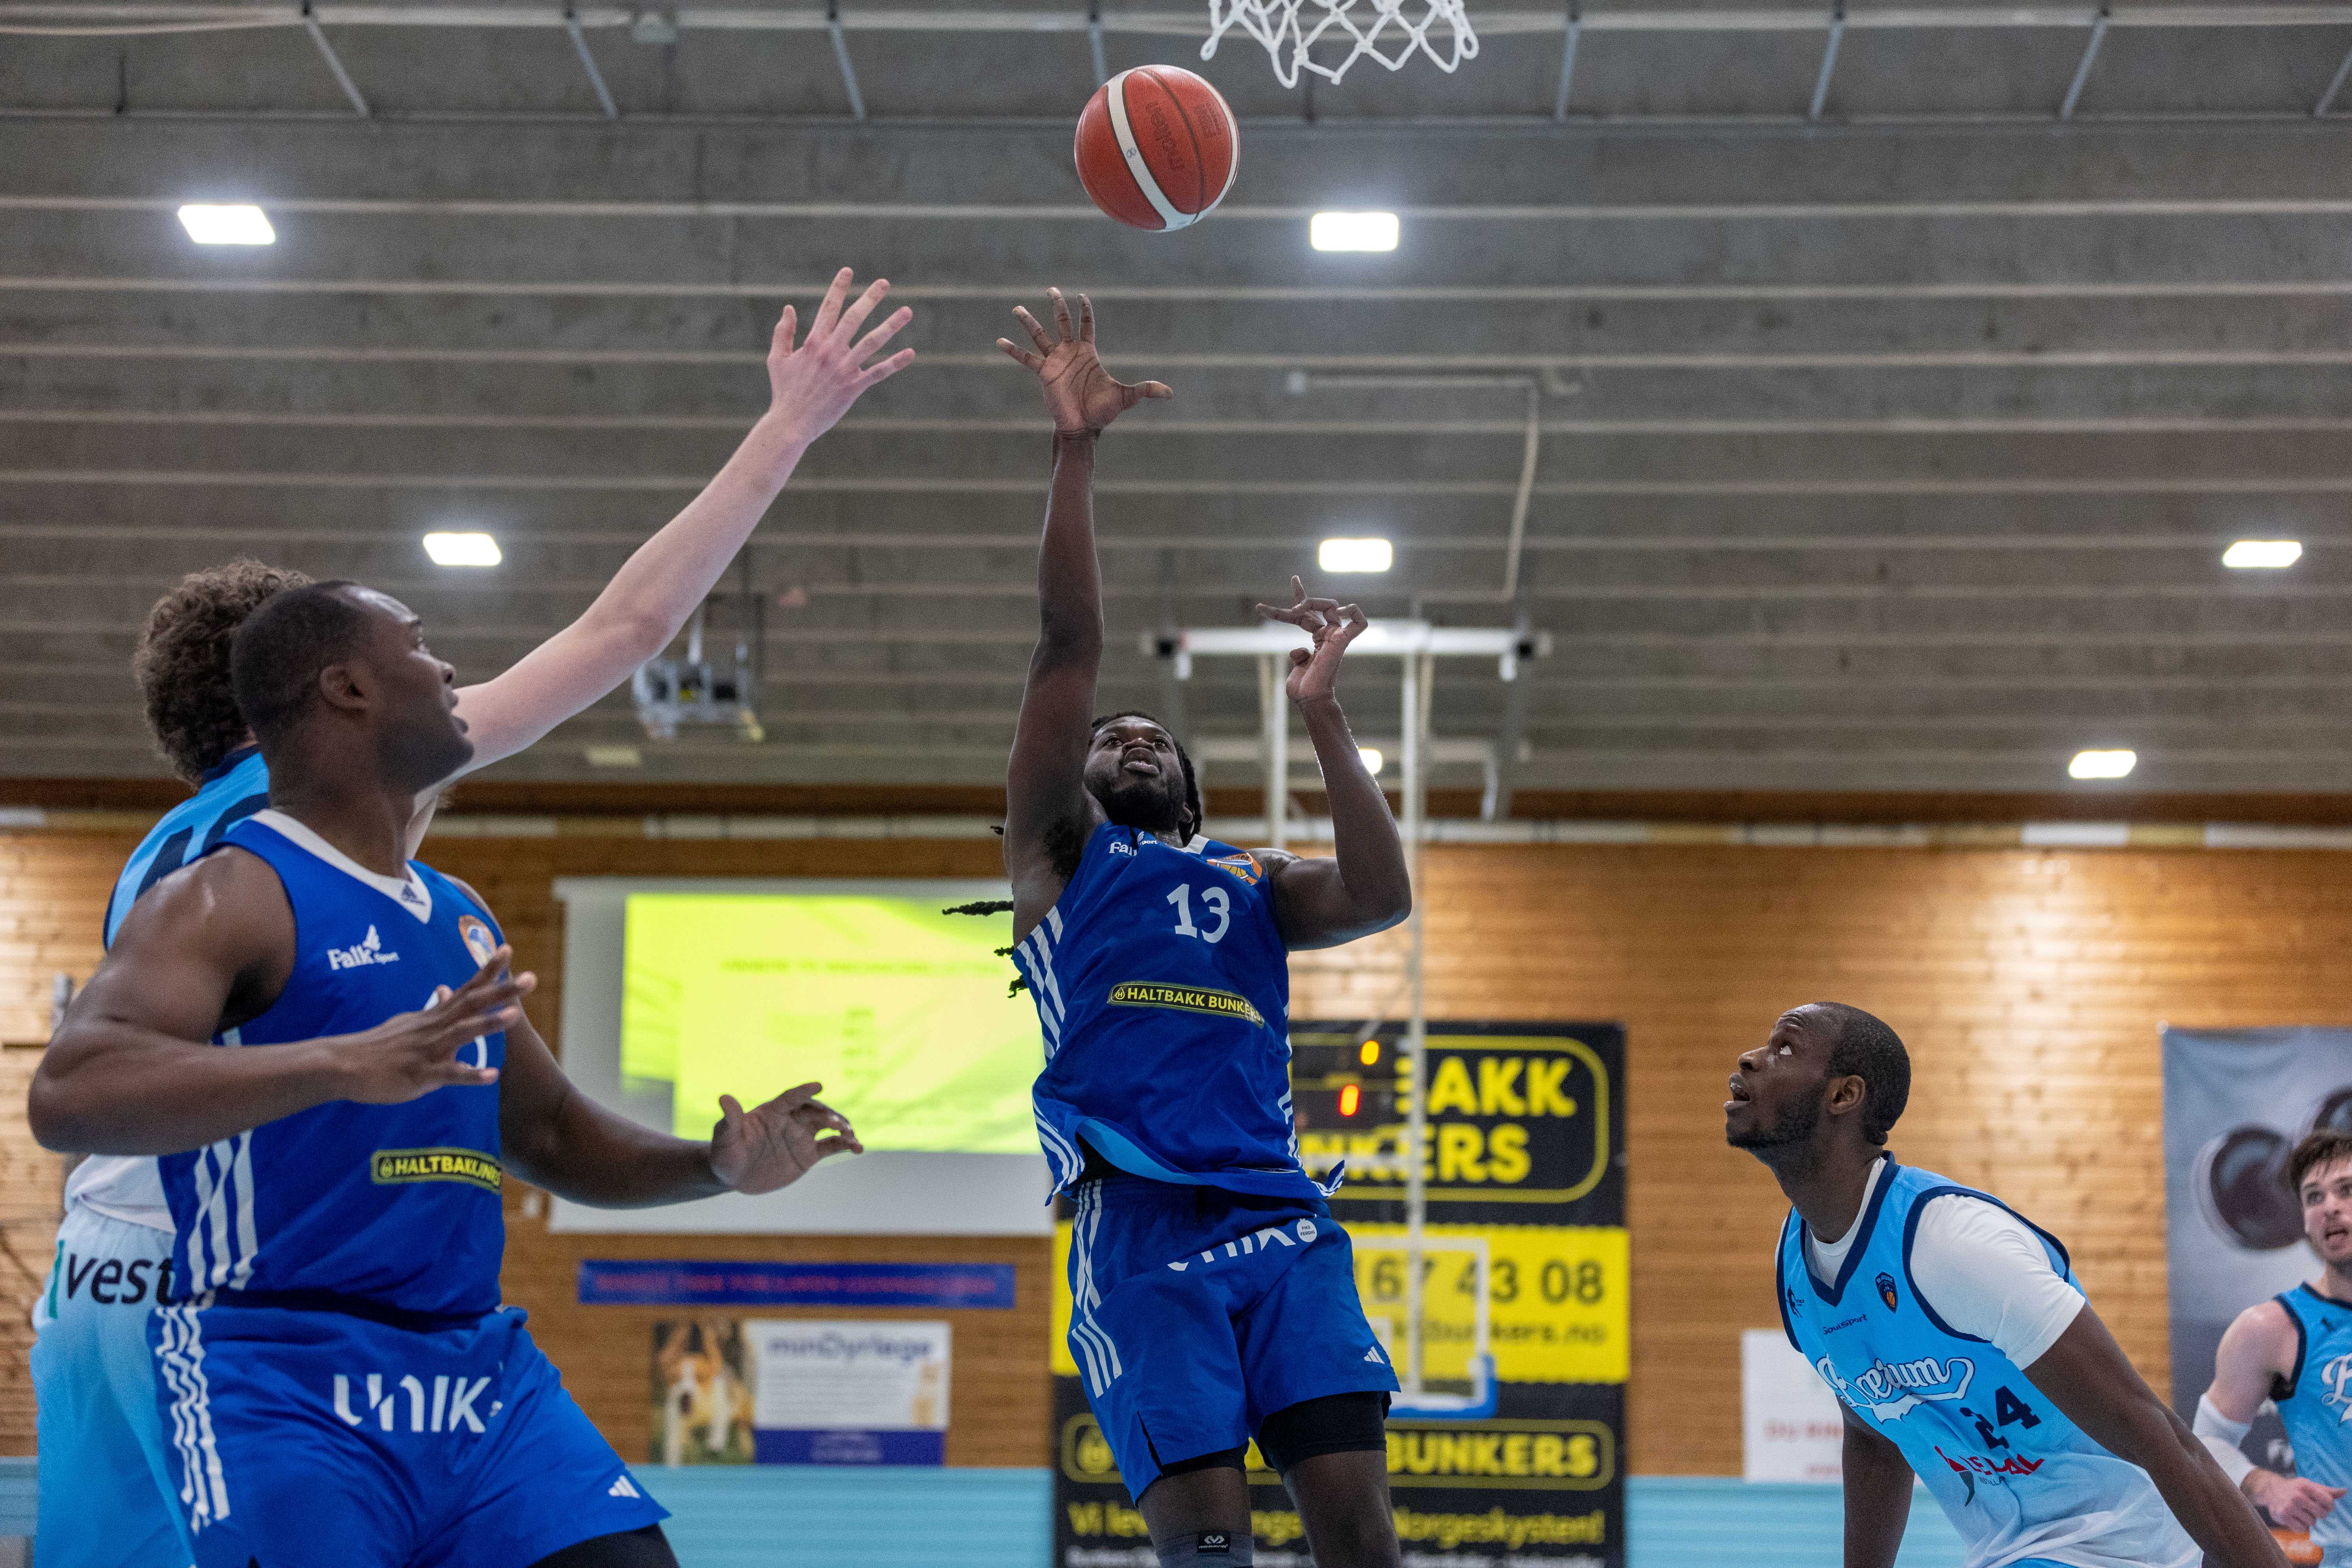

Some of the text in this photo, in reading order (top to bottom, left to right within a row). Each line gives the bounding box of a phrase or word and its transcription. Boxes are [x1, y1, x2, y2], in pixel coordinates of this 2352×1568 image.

[1166, 883, 1230, 944] 13
[327, 944, 377, 970] Falk
[1127, 988, 1206, 1006] HALTBAKK
[1539, 1258, 1605, 1305] 08
[1823, 1314, 1868, 1335] SoulSport
[1959, 1385, 2042, 1450] 24
